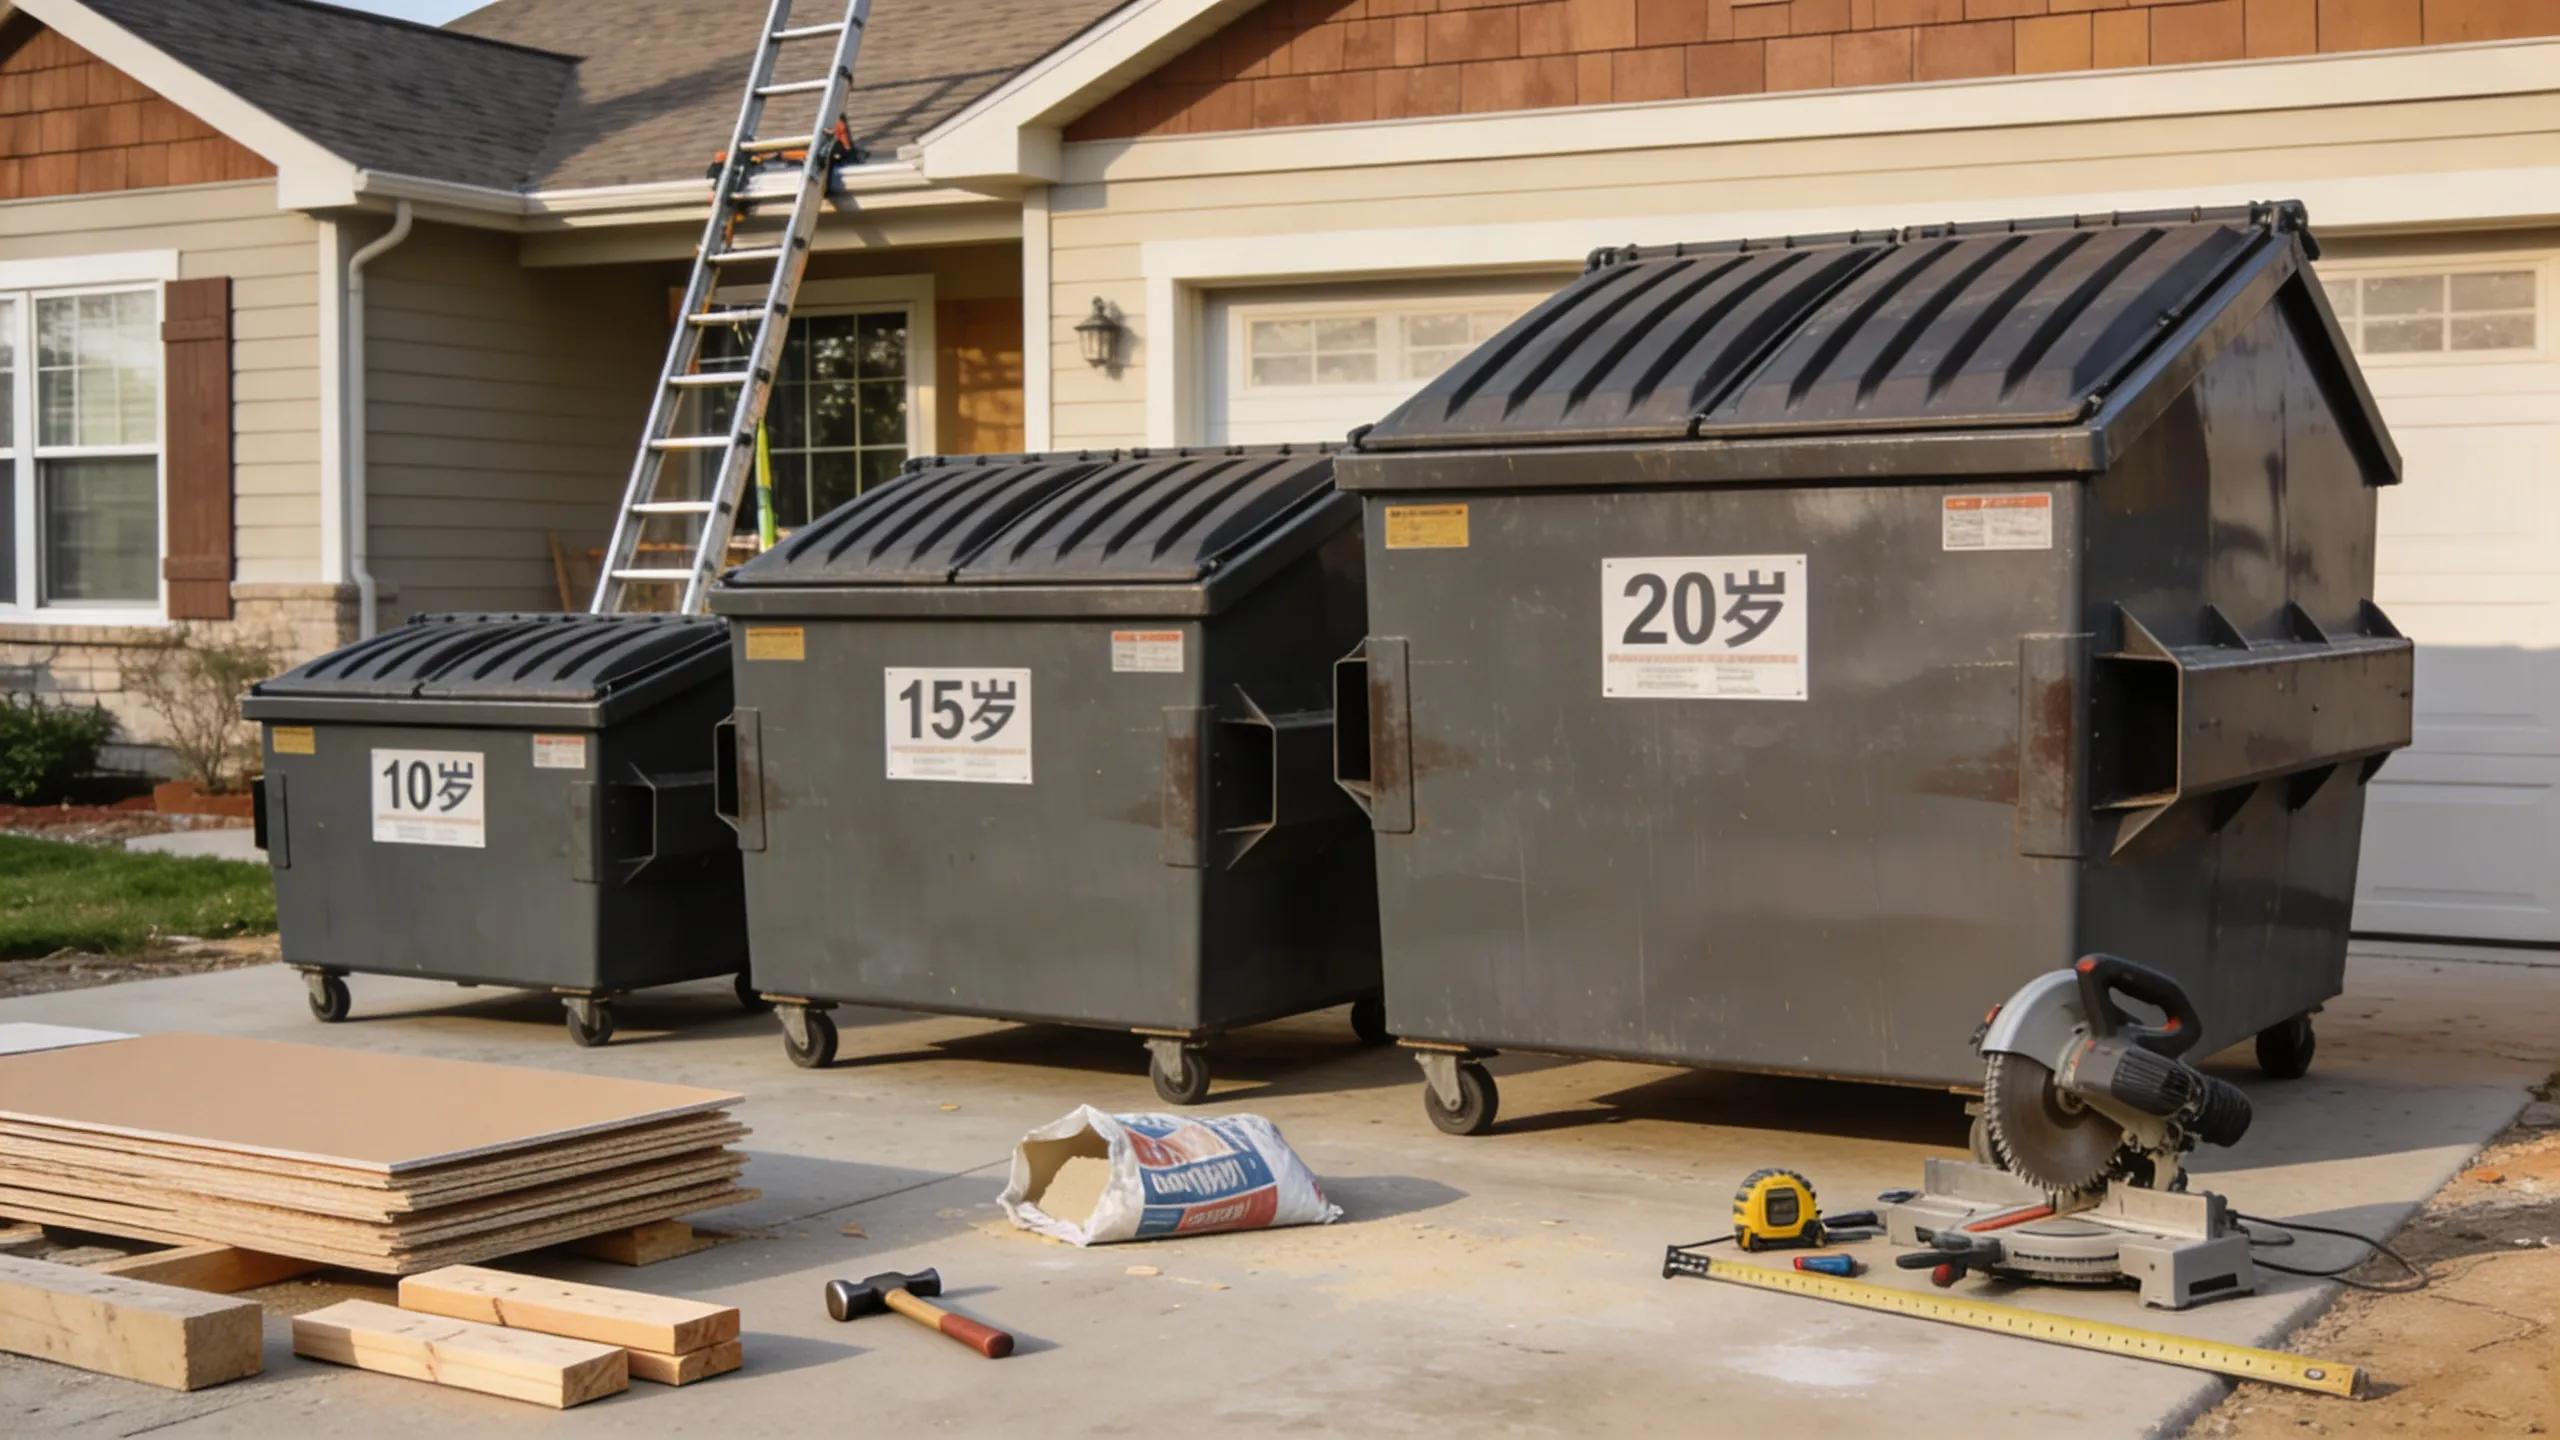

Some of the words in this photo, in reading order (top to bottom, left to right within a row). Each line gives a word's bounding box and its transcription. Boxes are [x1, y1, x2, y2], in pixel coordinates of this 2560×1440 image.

[1622, 570, 1785, 647] 20岁
[900, 679, 1016, 742] 15岁
[383, 760, 474, 812] 10岁
